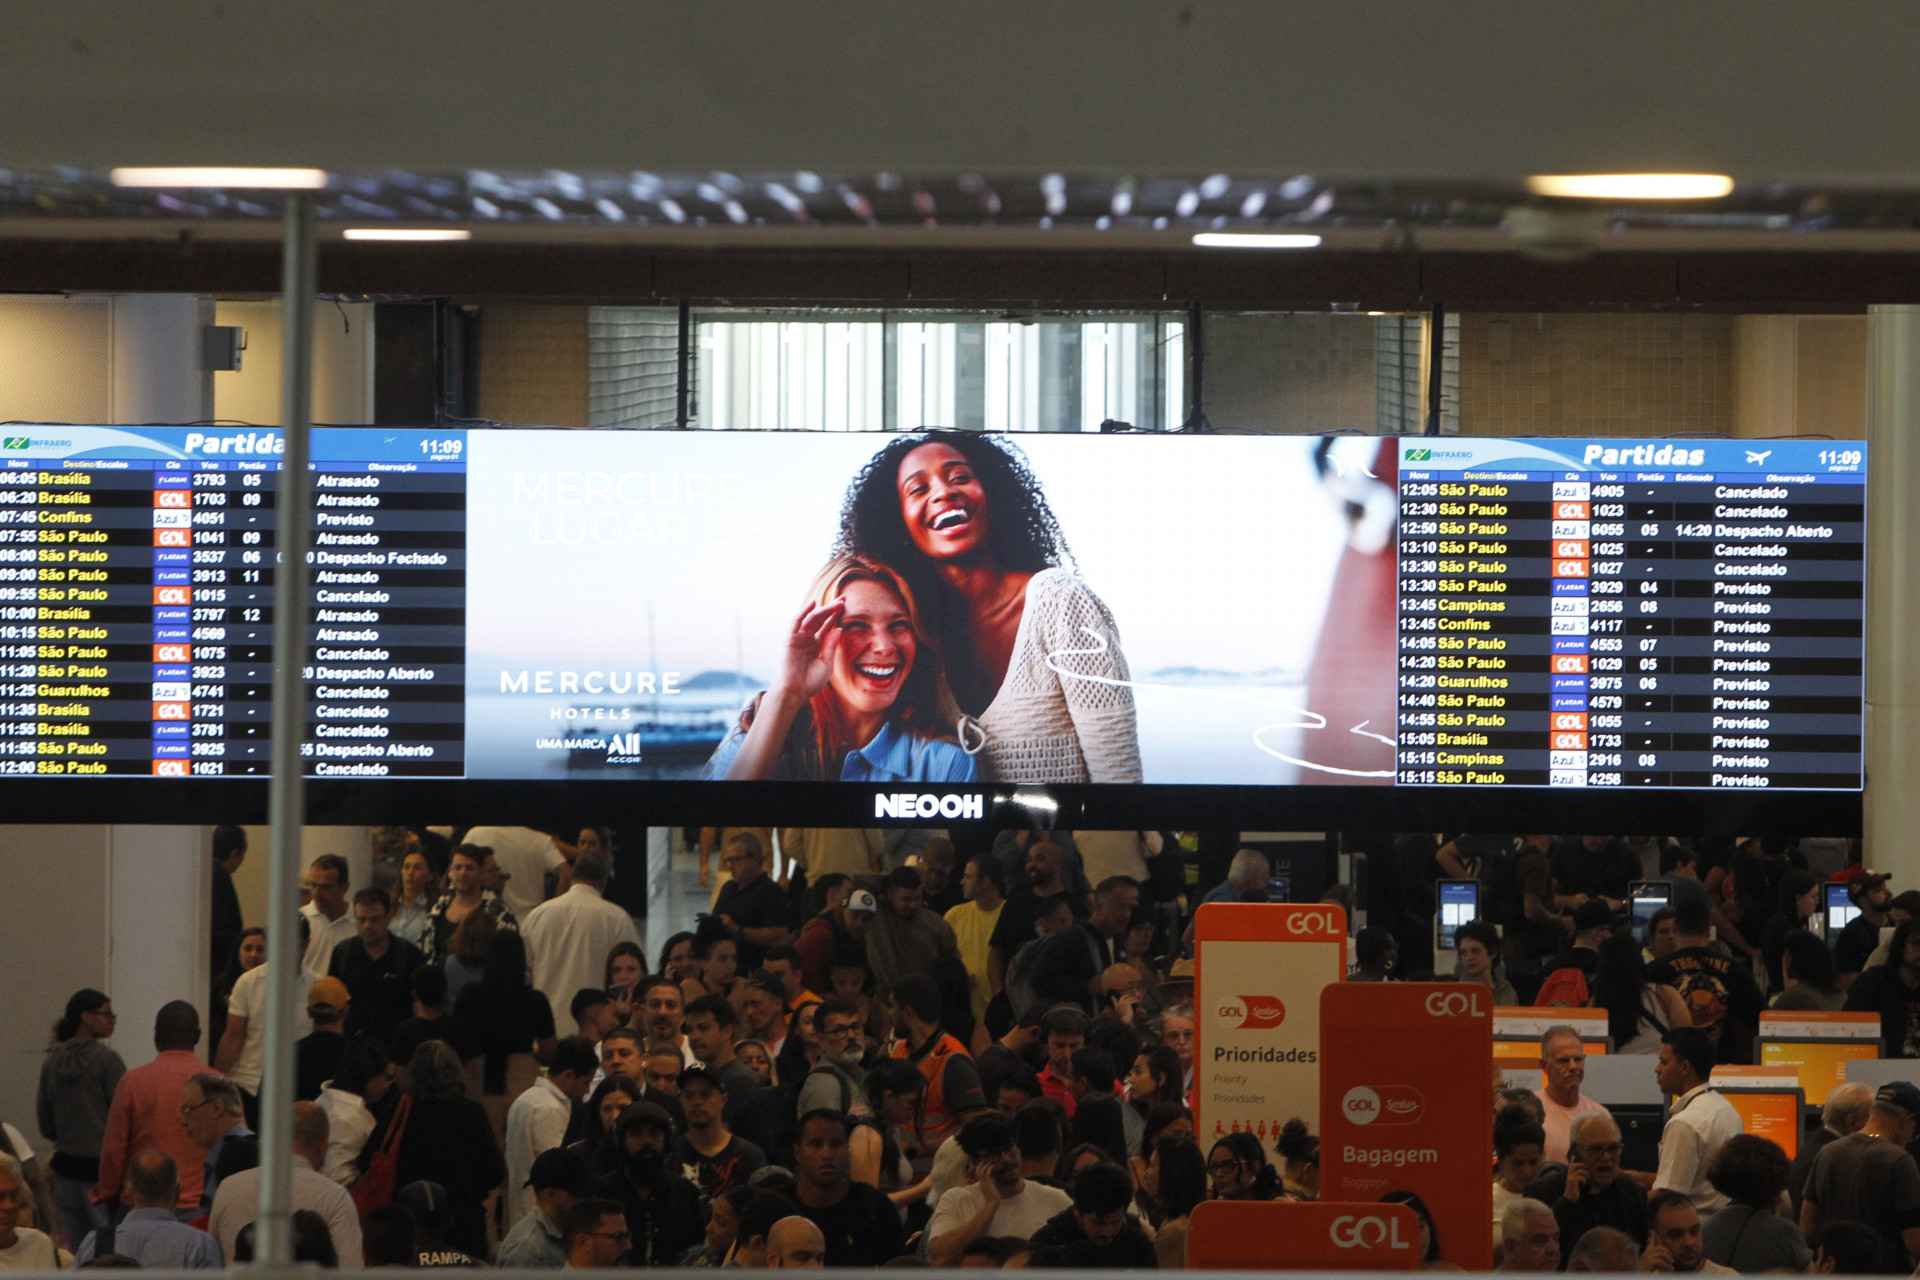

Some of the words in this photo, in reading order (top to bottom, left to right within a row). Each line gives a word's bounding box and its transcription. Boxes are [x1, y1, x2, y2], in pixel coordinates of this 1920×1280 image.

[184, 432, 285, 454] Partida
[420, 439, 463, 454] 11:09
[1583, 444, 1705, 466] Partidas
[1818, 450, 1862, 465] 11:09
[7, 459, 29, 468] Hora
[166, 461, 181, 470] Cia
[201, 461, 219, 470] Voo
[238, 461, 267, 470] Portão
[368, 462, 418, 473] Observação
[0, 471, 38, 485] 06:05
[38, 471, 92, 485] Brasília
[193, 473, 227, 487] 3793
[242, 473, 262, 487] 05
[316, 474, 380, 488] Atrasado
[1409, 471, 1430, 480] Hora
[1565, 472, 1580, 481] Cia
[1600, 472, 1618, 481] Voo
[1636, 473, 1665, 482] Portão
[1675, 473, 1714, 482] Estimado
[1766, 473, 1816, 484] Observação
[513, 471, 744, 506] MERCURE
[1400, 483, 1438, 497] 12:05
[1438, 483, 1466, 497] São
[1468, 483, 1508, 497] Paulo
[1555, 487, 1577, 497] Azul
[1591, 484, 1625, 498] 4905
[1714, 485, 1789, 499] Cancelado
[0, 490, 38, 504] 06:20
[38, 490, 91, 504] Brasília
[158, 492, 188, 508] GOL
[193, 492, 227, 506] 1703
[242, 492, 261, 506] 09
[316, 493, 380, 507] Atrasado
[0, 510, 38, 524] 07:45
[37, 510, 93, 524] Confins
[156, 514, 178, 524] Azul
[193, 511, 225, 525] 4051
[317, 512, 375, 526] Previsto
[1400, 502, 1438, 516] 12:30
[1438, 502, 1466, 516] São
[1468, 502, 1508, 516] Paulo
[1557, 503, 1587, 519] GOL
[1592, 503, 1625, 517] 1023
[1714, 504, 1788, 519] Cancelado
[530, 511, 690, 546] LUGAR
[1400, 521, 1438, 535] 12:50
[1438, 521, 1466, 535] São
[1468, 521, 1508, 535] Paulo
[1555, 525, 1576, 535] Azul
[1590, 522, 1625, 537] 6055
[1640, 523, 1659, 537] 05
[1675, 523, 1713, 537] 14:20
[1714, 523, 1784, 540] Despacho
[1784, 524, 1833, 538] Aberto
[0, 548, 37, 562] 08:00
[37, 548, 66, 562] São
[68, 549, 109, 563] Paulo
[192, 550, 227, 564] 3537
[242, 550, 261, 564] 06
[316, 550, 387, 567] Despacho
[387, 551, 448, 565] Fechado
[0, 567, 37, 581] 09:00
[37, 568, 66, 581] São
[68, 568, 108, 582] Paulo
[192, 569, 226, 583] 3913
[242, 569, 259, 583] 11
[316, 570, 380, 584] Atrasado
[1400, 578, 1437, 592] 13:30
[1437, 579, 1465, 592] São
[1467, 579, 1507, 593] Paulo
[1590, 580, 1624, 594] 3929
[1640, 581, 1659, 594] 04
[1714, 581, 1772, 595] Previsto
[0, 606, 37, 620] 10:00
[37, 606, 91, 620] Brasília
[192, 607, 226, 621] 3797
[242, 608, 261, 622] 12
[315, 608, 380, 622] Atrasado
[1399, 598, 1437, 612] 13:45
[1437, 598, 1506, 614] Campinas
[1554, 602, 1576, 612] Azul
[1590, 599, 1624, 613] 2656
[1639, 600, 1658, 614] 08
[1713, 600, 1772, 615] Previsto
[1399, 636, 1437, 650] 14:05
[1437, 636, 1465, 650] São
[1467, 636, 1507, 650] Paulo
[1589, 638, 1623, 652] 4553
[1639, 638, 1658, 652] 07
[1713, 639, 1771, 653] Previsto
[500, 670, 682, 694] MERCURE
[1399, 674, 1436, 688] 14:20
[1437, 674, 1509, 689] Guarulhos
[1589, 676, 1623, 690] 3975
[1639, 676, 1657, 690] 06
[1712, 677, 1771, 692] Previsto
[0, 683, 37, 697] 11:25
[37, 683, 110, 697] Guarulhos
[155, 687, 177, 697] Azul
[191, 684, 224, 698] 4741
[315, 685, 390, 699] Cancelado
[0, 702, 37, 716] 11:35
[37, 702, 91, 716] Brasília
[157, 703, 187, 720] GOL
[192, 703, 224, 717] 1721
[315, 704, 390, 718] Cancelado
[550, 707, 631, 720] HOTELS
[536, 738, 563, 750] UMA
[564, 738, 608, 750] MARCA
[1398, 732, 1436, 746] 15:05
[1436, 732, 1488, 746] Brasília
[1555, 733, 1584, 749] GOL
[1589, 734, 1622, 748] 1733
[1712, 735, 1770, 749] Previsto
[0, 760, 36, 774] 12:00
[36, 760, 65, 774] São
[67, 761, 107, 774] Paulo
[157, 761, 187, 775] GOL
[192, 761, 224, 775] 1021
[315, 762, 389, 776] Cancelado
[1398, 751, 1436, 765] 15:15
[1436, 751, 1505, 768] Campinas
[1553, 755, 1574, 765] Azul
[1588, 753, 1622, 767] 2916
[1638, 753, 1657, 767] 08
[1712, 754, 1770, 768] Previsto
[875, 793, 984, 819] NEOOH
[1286, 912, 1340, 935] GOL
[1218, 1006, 1244, 1018] GOL
[1425, 992, 1486, 1018] GOL
[1214, 1047, 1317, 1063] Prioridades
[1213, 1074, 1248, 1086] Priority
[1347, 1099, 1376, 1112] GOL
[1343, 1146, 1438, 1167] Bagagem
[1330, 1215, 1410, 1249] GOL
[418, 1251, 472, 1266] RAMPA
